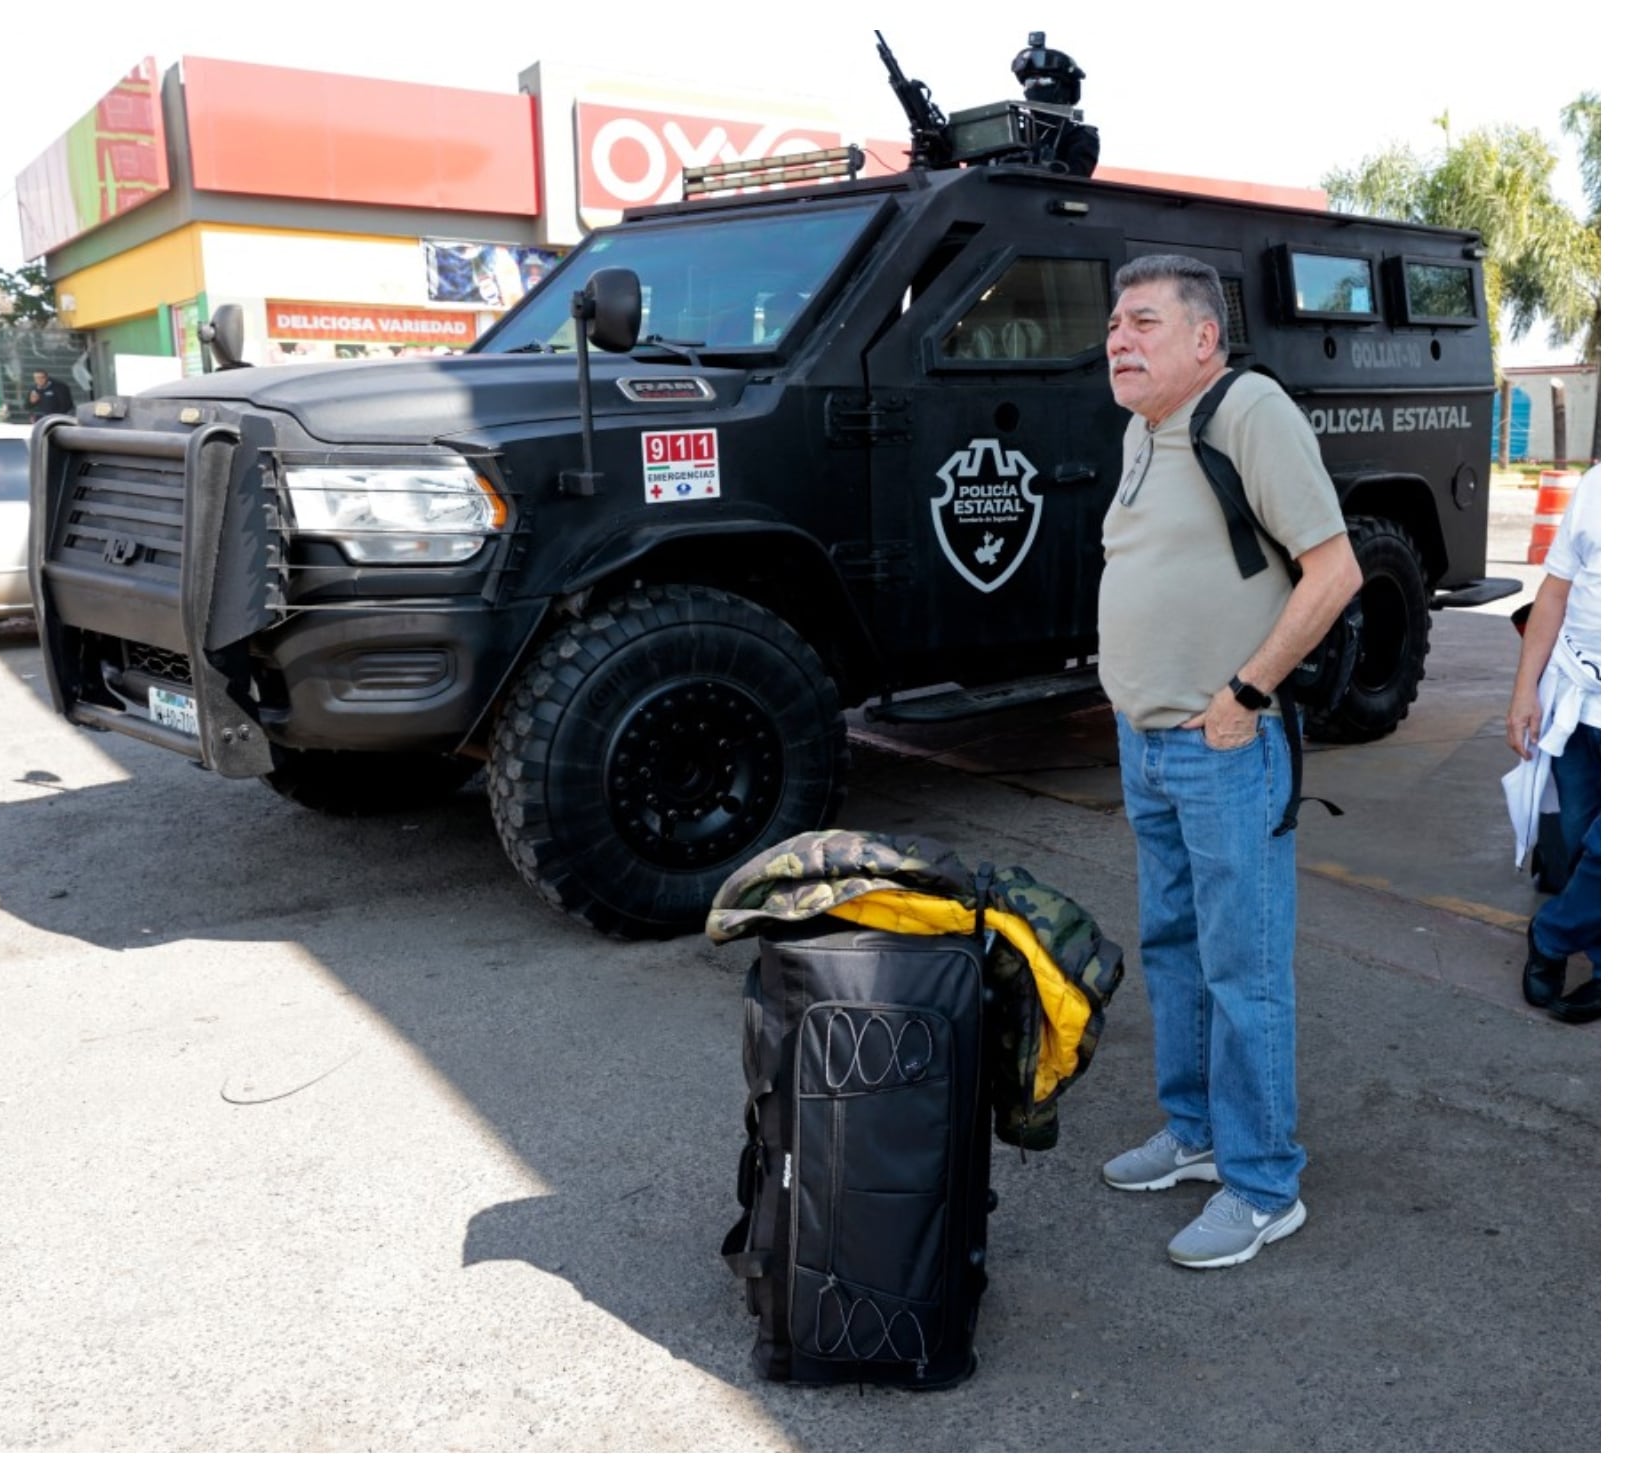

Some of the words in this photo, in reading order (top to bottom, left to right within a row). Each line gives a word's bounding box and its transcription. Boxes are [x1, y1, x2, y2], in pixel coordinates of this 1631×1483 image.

[277, 314, 375, 332] DELICIOSA
[378, 317, 466, 334] VARIEDAD
[1351, 339, 1421, 369] GOLIAT-10
[634, 382, 695, 391] RAM
[1392, 406, 1472, 432] ESTATAL
[650, 435, 709, 461] 911
[647, 470, 715, 482] EMERGENCIAS
[959, 481, 1018, 498] POLICÍA
[954, 499, 1024, 515] ESTATAL
